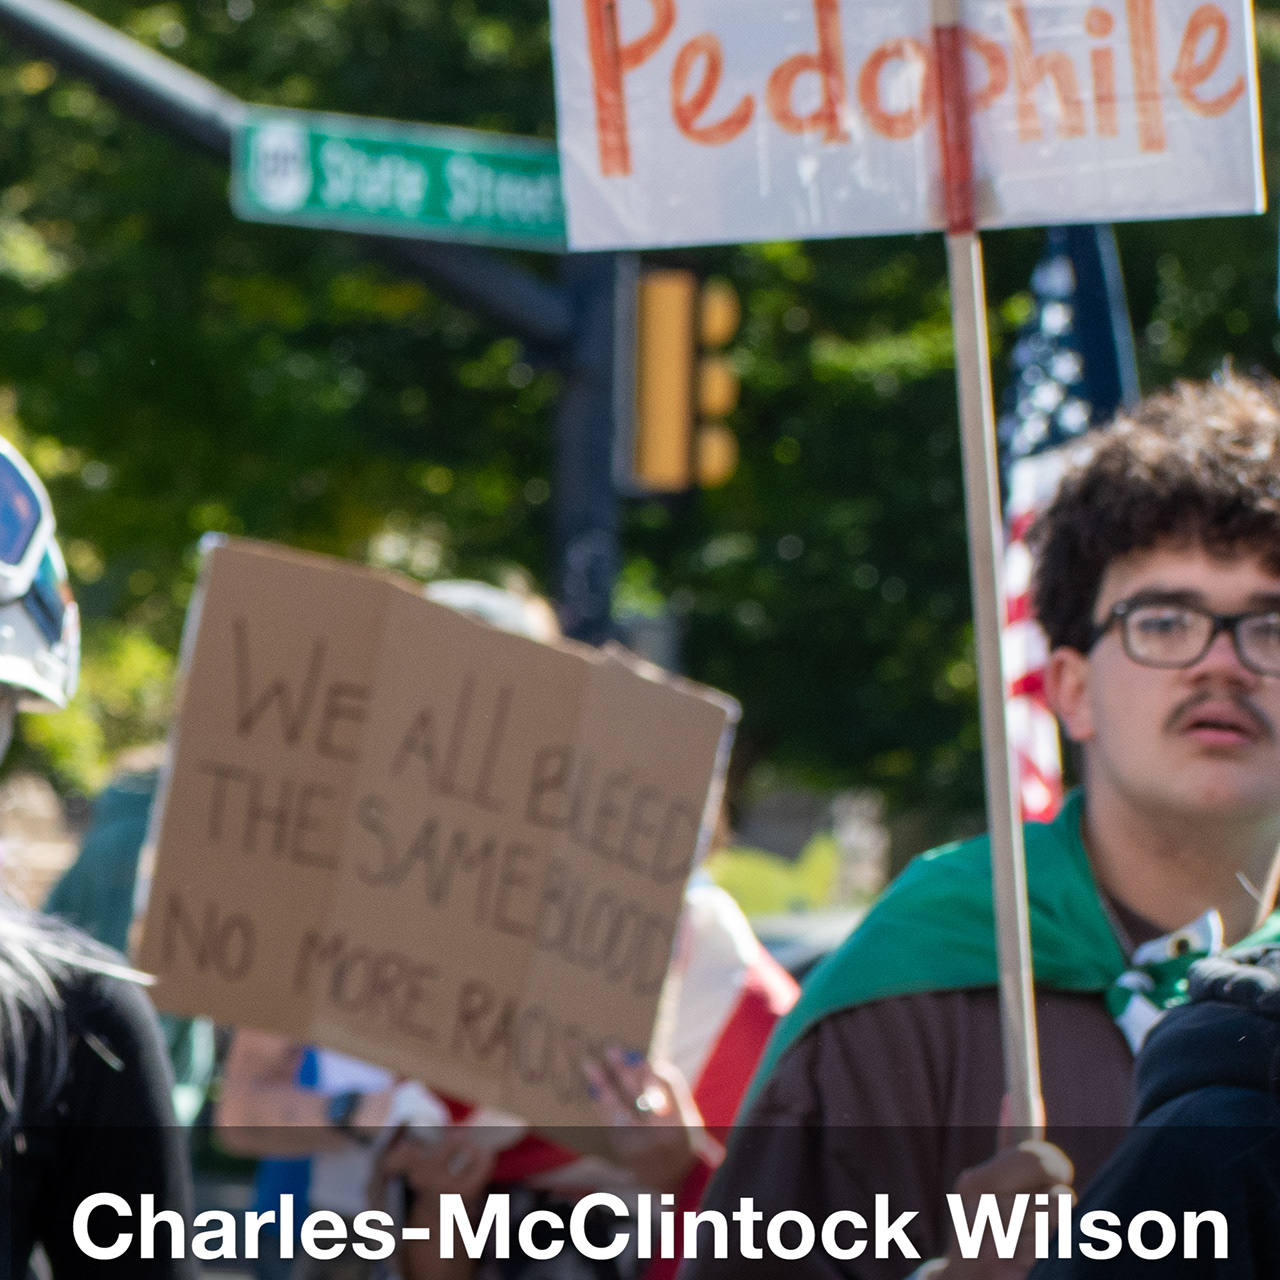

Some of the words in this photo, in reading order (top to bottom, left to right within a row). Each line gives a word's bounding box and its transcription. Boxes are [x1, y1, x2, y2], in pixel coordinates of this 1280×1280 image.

[320, 138, 428, 217] State
[584, 0, 1244, 232] Pedophile
[197, 759, 339, 871] THE
[230, 617, 371, 764] WE
[524, 742, 692, 884] BLEED
[159, 893, 258, 982] NO
[292, 927, 442, 1044] MORE
